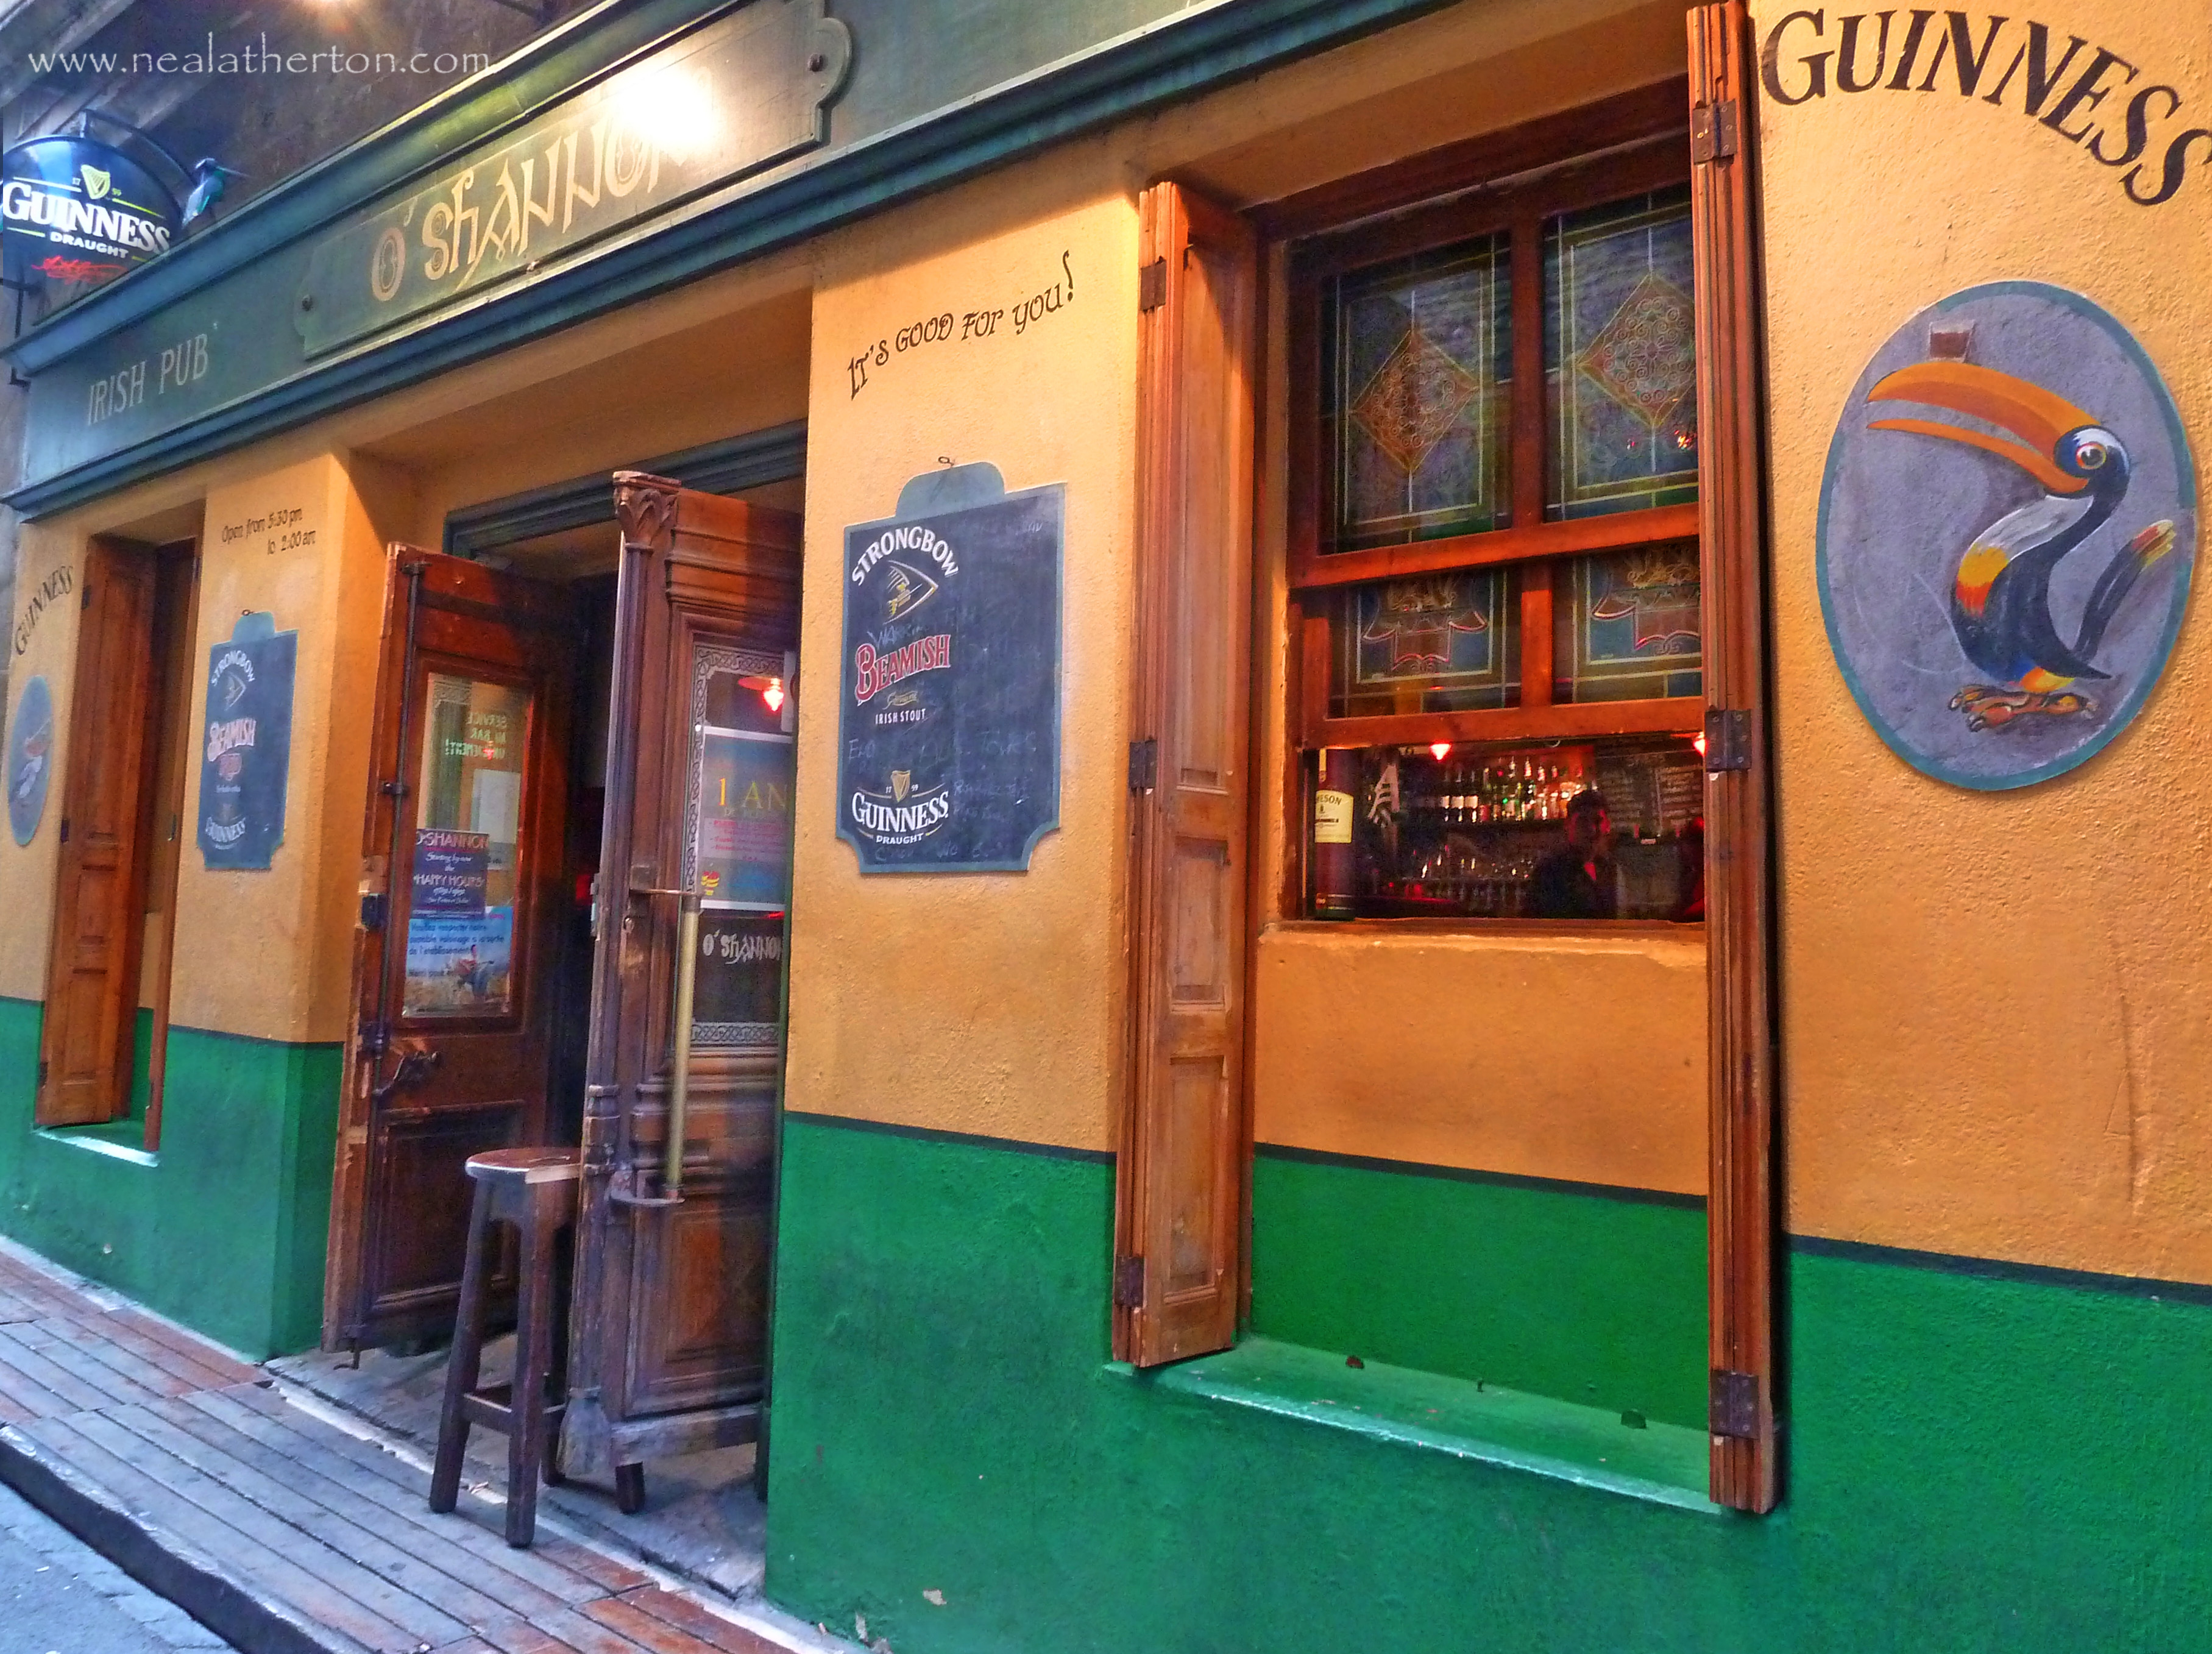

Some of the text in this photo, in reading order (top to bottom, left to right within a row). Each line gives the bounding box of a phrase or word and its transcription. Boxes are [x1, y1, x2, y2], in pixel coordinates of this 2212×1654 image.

[1761, 9, 2212, 205] GUINNESS
[2, 182, 170, 255] GUINNESS
[50, 231, 129, 258] DRAUGHT
[896, 313, 954, 353] GOOD
[88, 333, 208, 426] IRISH PUB
[852, 526, 959, 586] STRONGBOW
[15, 566, 73, 655] GUINNESS
[211, 650, 255, 686] STRONGBOW
[855, 634, 952, 707] BEAMISH
[875, 709, 926, 725] IRISH STOUT
[852, 791, 949, 833] GUINNESS
[876, 833, 924, 845] DRAUGHT
